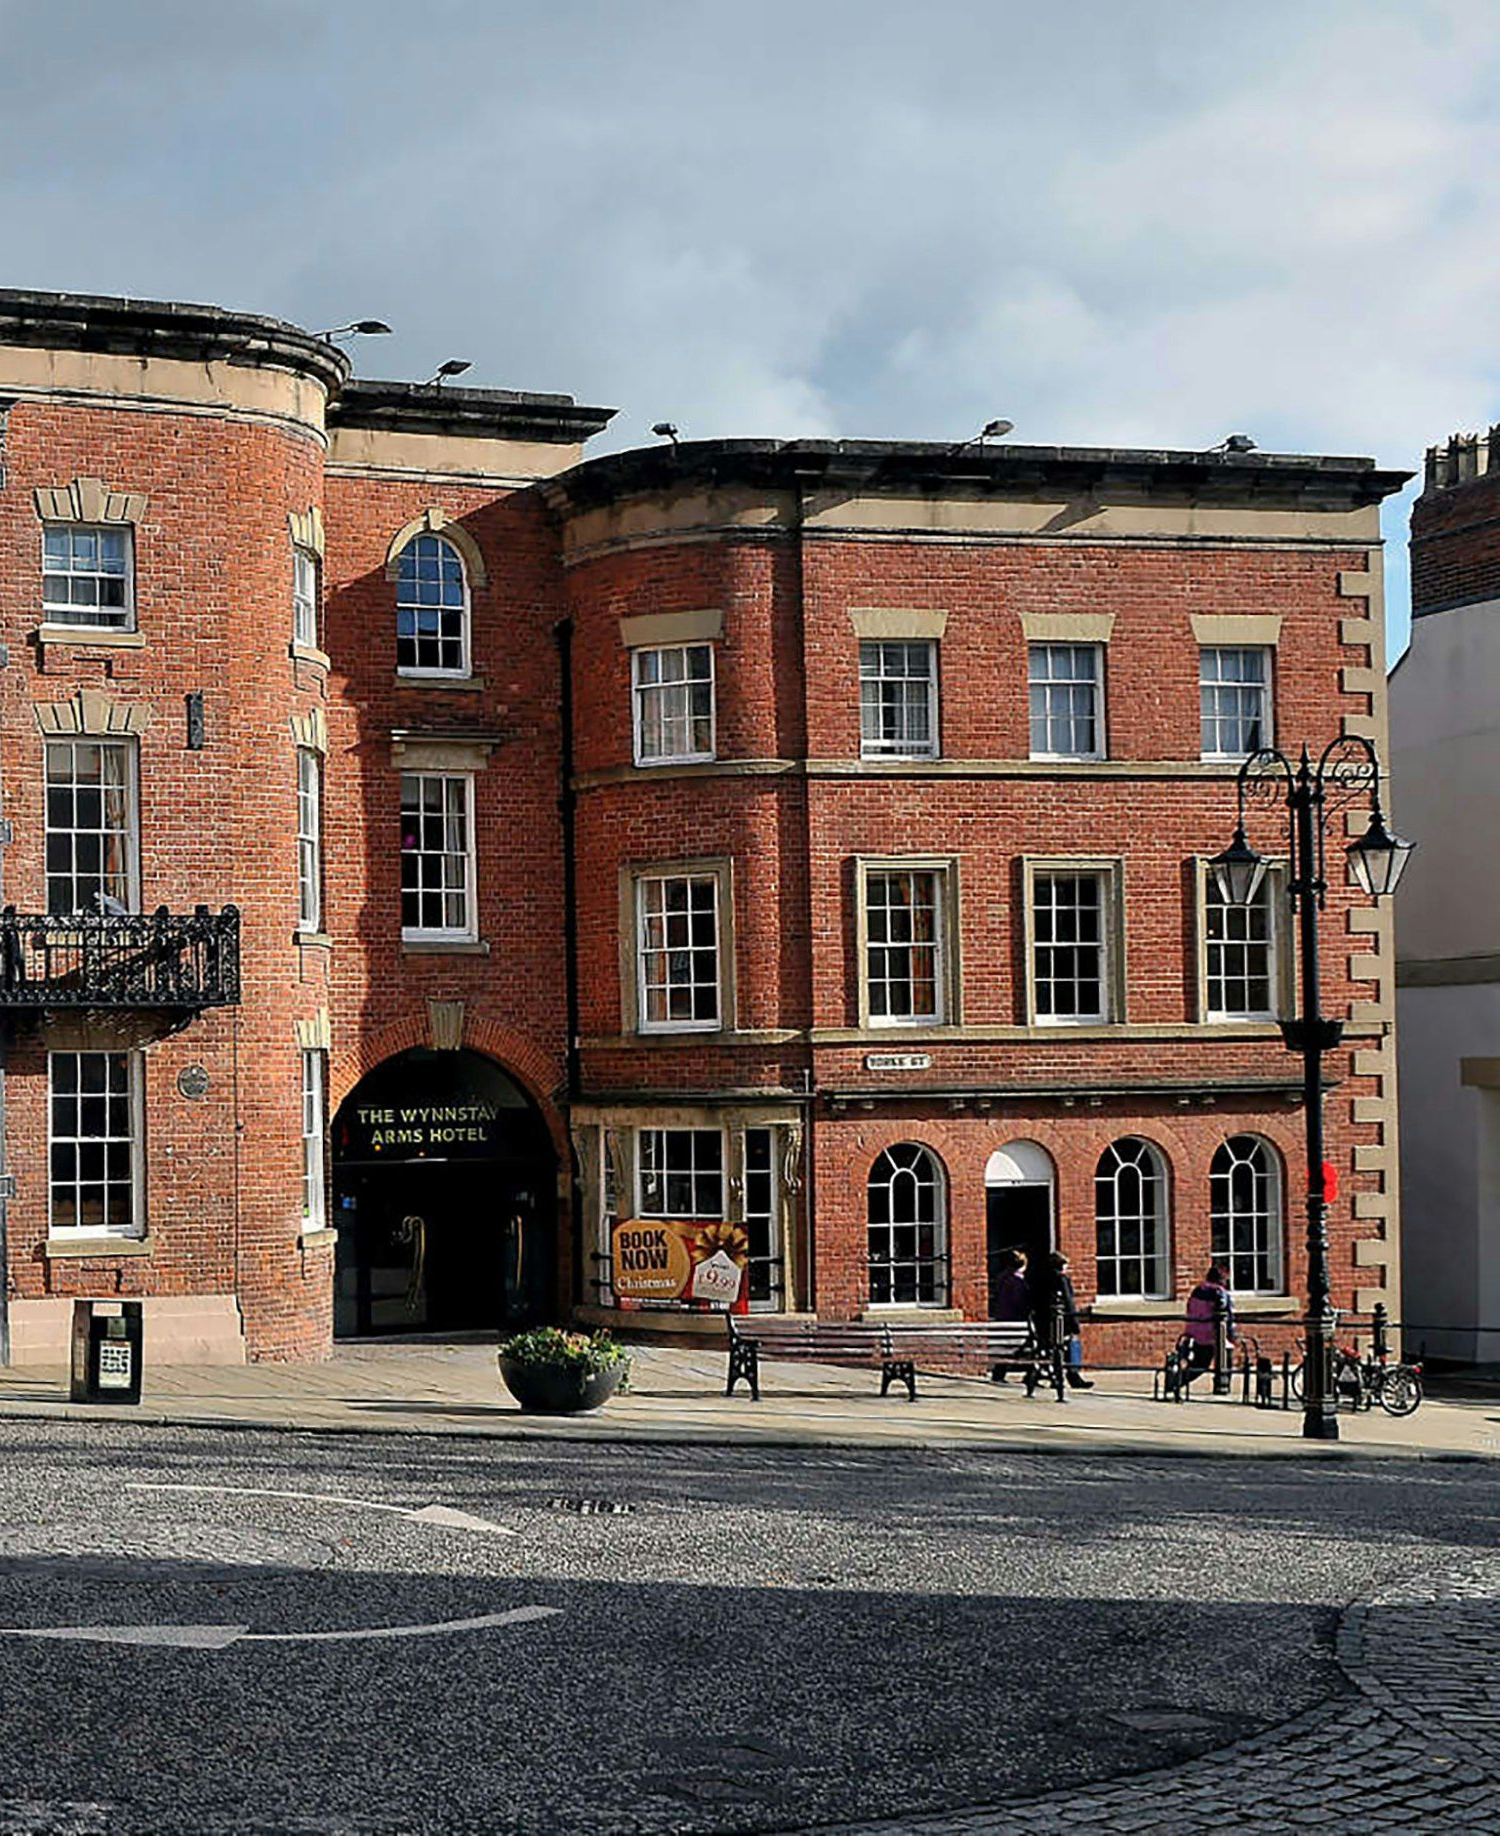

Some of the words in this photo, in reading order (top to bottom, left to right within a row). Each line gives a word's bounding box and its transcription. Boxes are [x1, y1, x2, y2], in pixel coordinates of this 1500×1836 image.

[357, 1109, 395, 1125] THE
[399, 1104, 500, 1124] WYNNSTAY
[371, 1128, 424, 1145] ARMS
[429, 1127, 488, 1143] HOTEL
[619, 1229, 668, 1249] BOOK
[620, 1249, 668, 1271] NOW
[616, 1275, 677, 1290] Christmas
